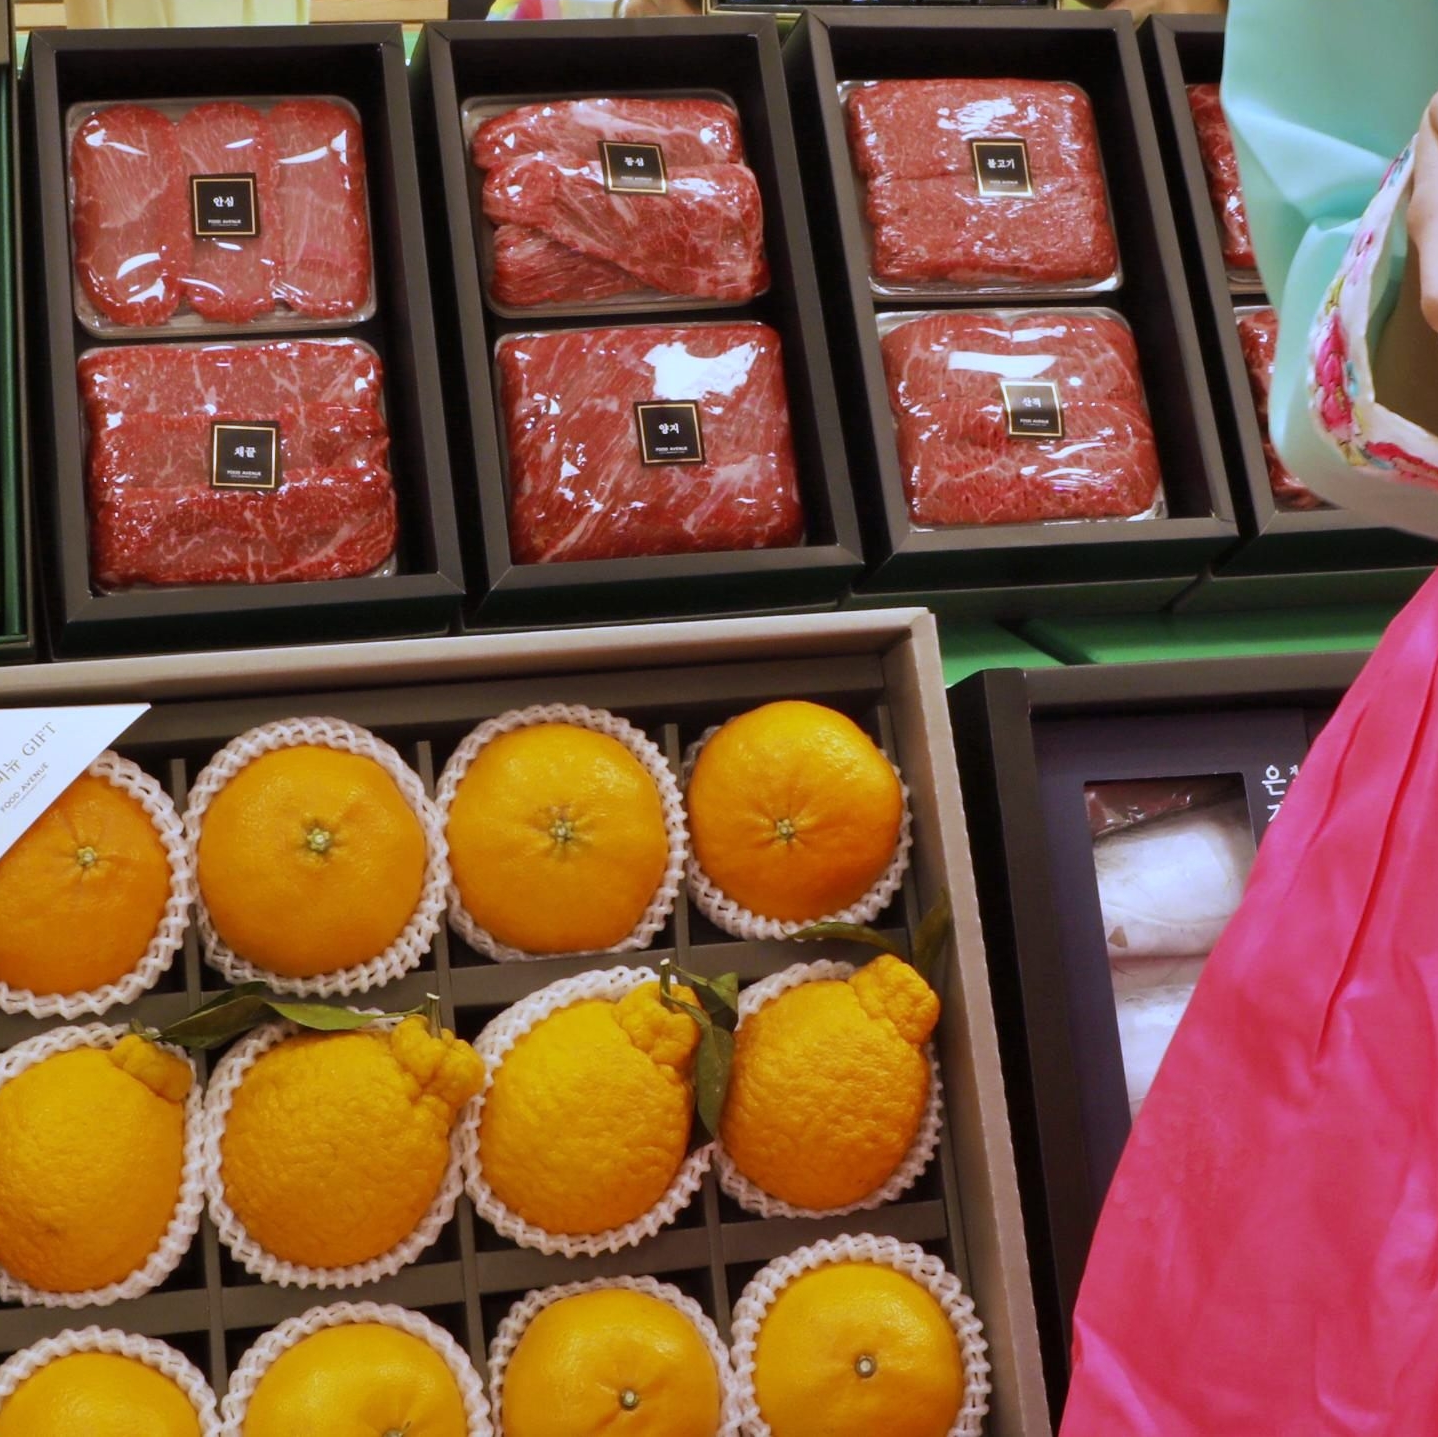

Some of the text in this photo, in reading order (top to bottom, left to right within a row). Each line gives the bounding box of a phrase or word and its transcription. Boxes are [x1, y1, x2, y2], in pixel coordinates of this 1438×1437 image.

[987, 158, 1015, 169] 불고기
[213, 195, 234, 208] 안심
[658, 422, 680, 435] 양지
[21, 721, 57, 757] GIFT
[0, 762, 50, 814] FOOD AVENUE
